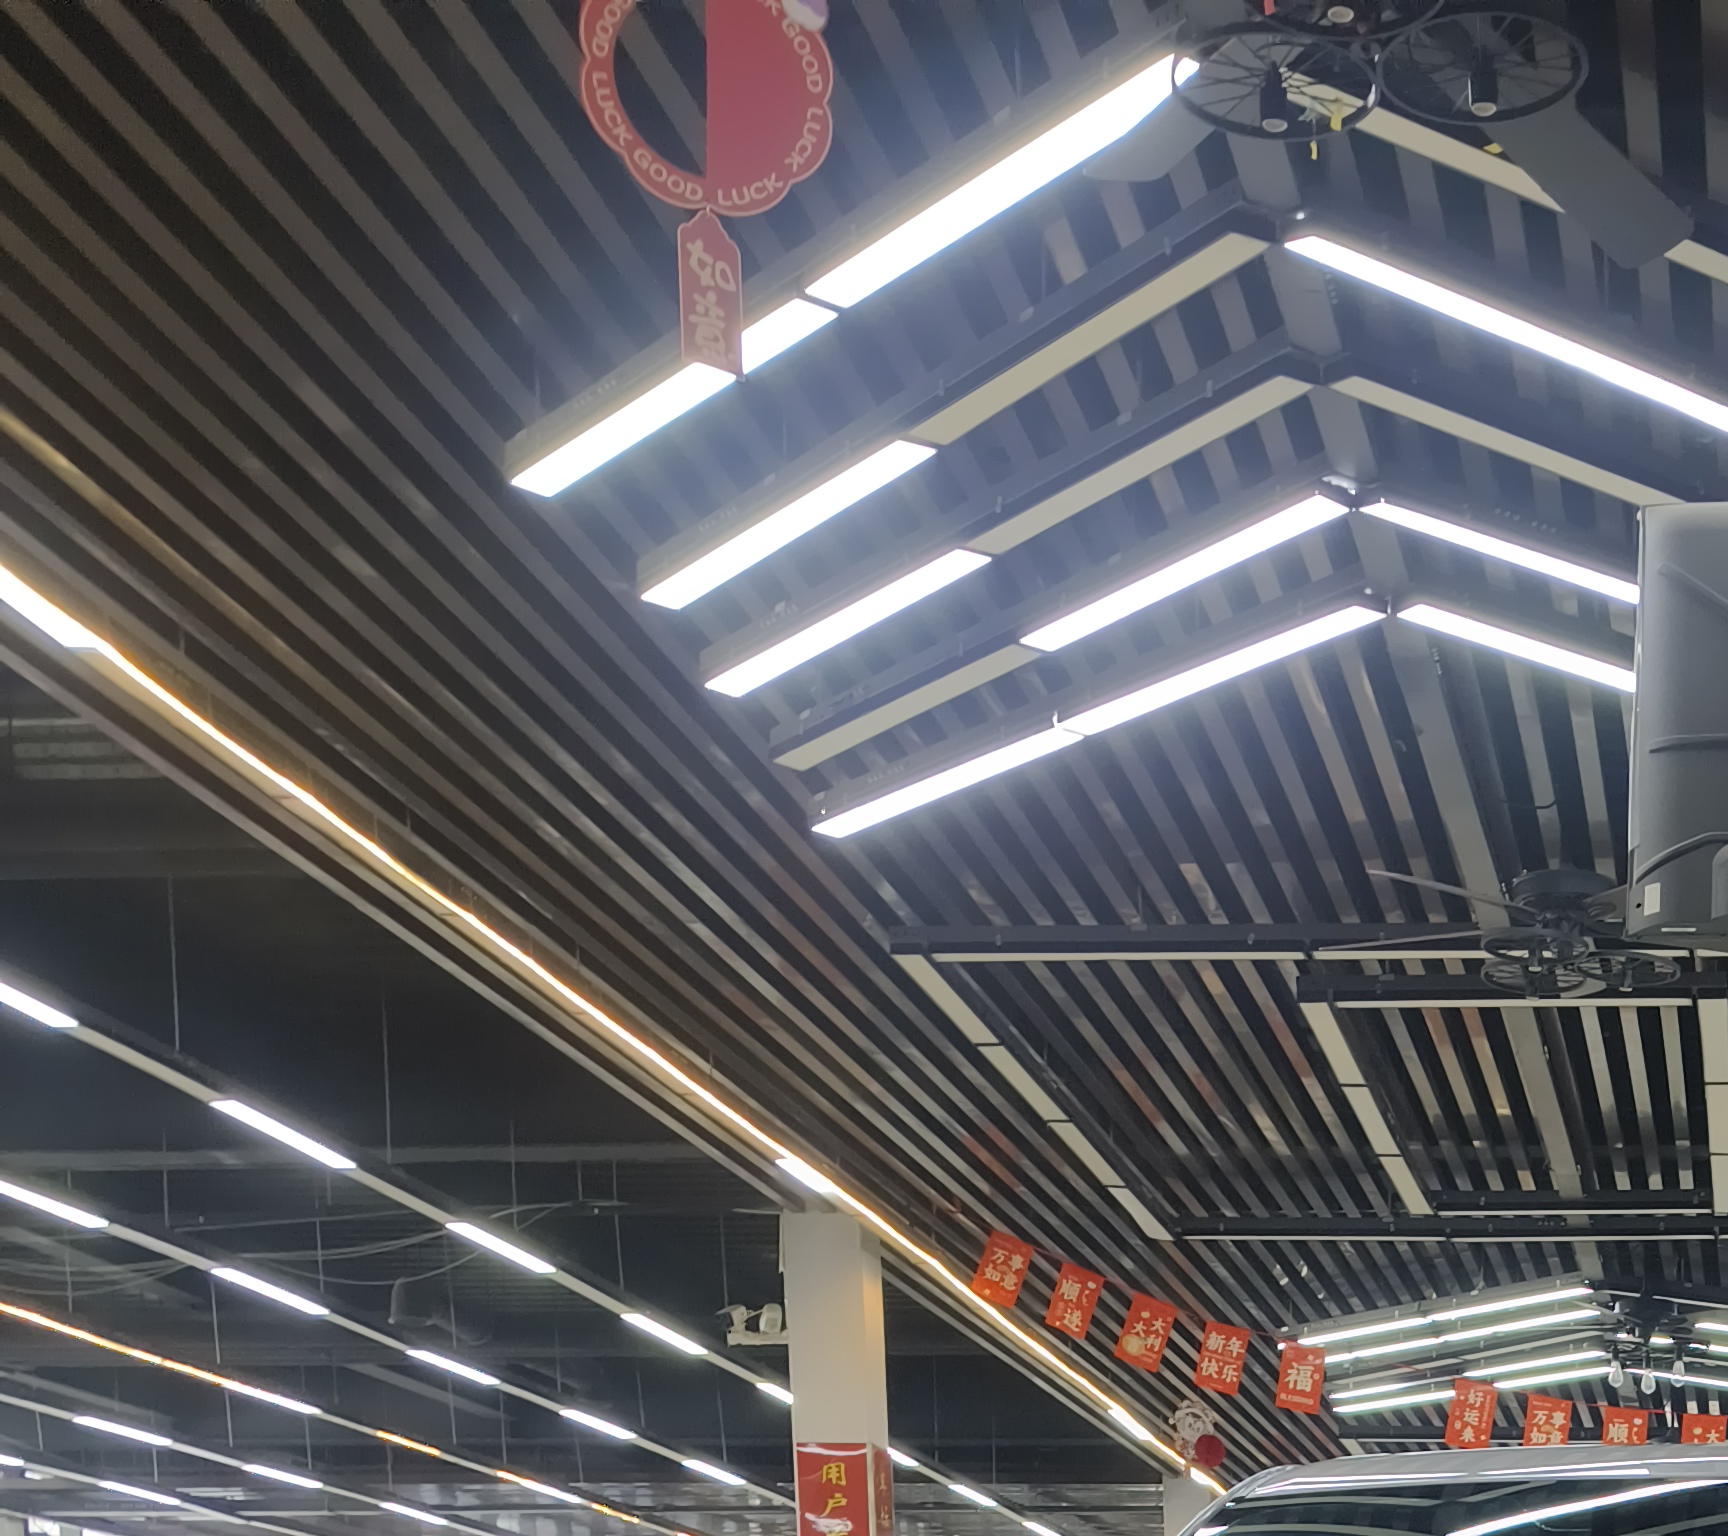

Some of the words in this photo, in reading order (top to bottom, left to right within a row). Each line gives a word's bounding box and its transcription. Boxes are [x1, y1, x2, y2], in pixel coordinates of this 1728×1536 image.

[782, 17, 822, 93] GOOD
[592, 71, 633, 147] LUCK
[633, 148, 703, 201] GOOD
[717, 172, 784, 206] LUCK
[784, 106, 824, 172] LUCK
[991, 1247, 1025, 1272] 万事
[984, 1263, 1018, 1291] 如意
[1205, 1331, 1245, 1357] 新年
[1200, 1357, 1239, 1383] 快乐
[1283, 1362, 1315, 1393] 福
[1459, 1388, 1484, 1443] 好运来
[1532, 1411, 1567, 1429] 万事
